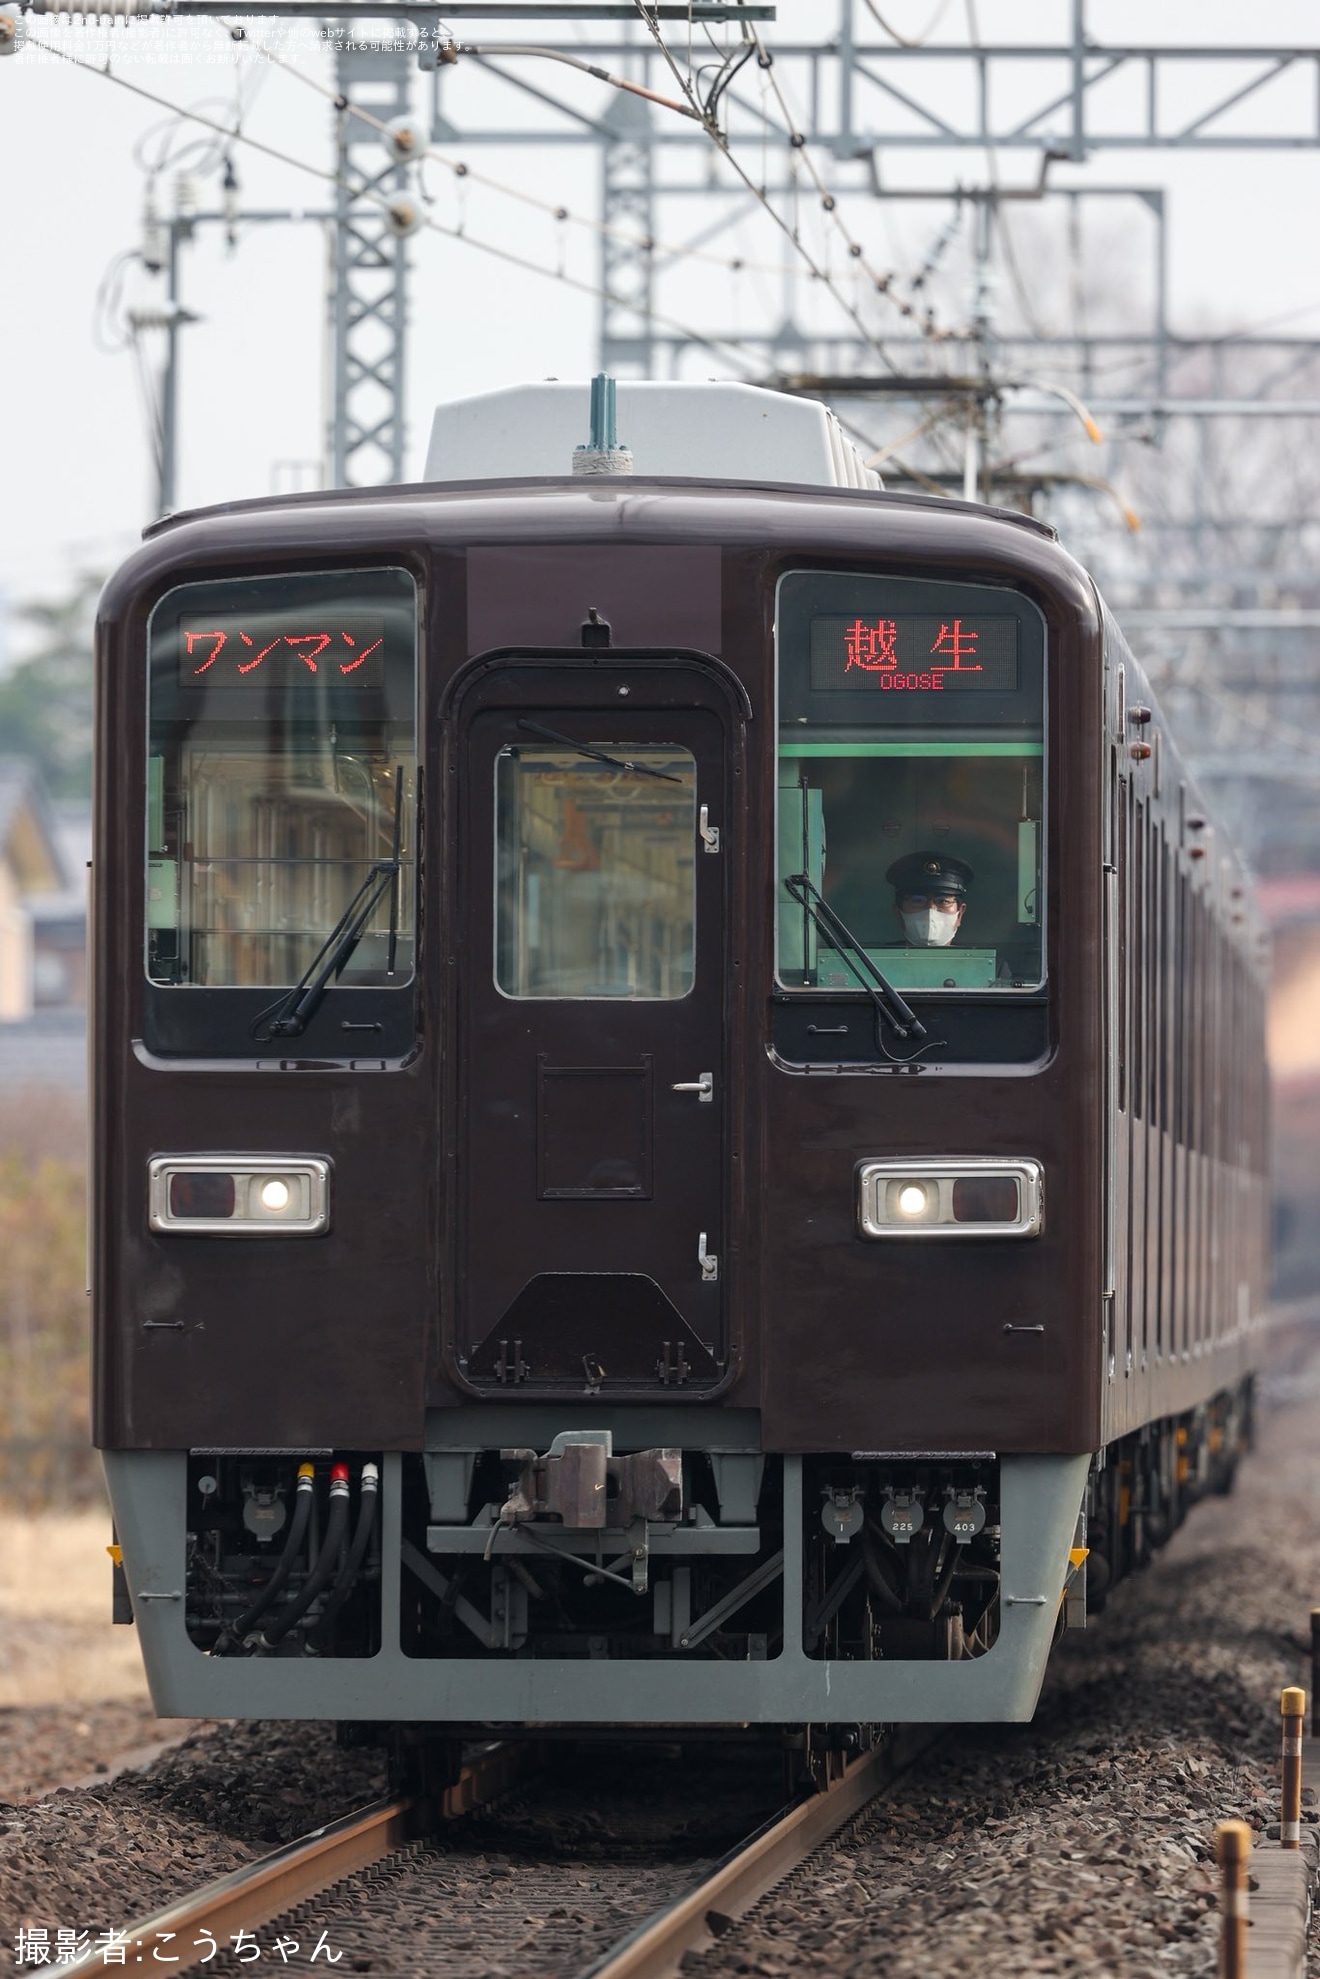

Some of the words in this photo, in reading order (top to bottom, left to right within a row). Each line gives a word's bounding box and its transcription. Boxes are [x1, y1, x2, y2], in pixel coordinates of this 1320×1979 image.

[184, 631, 383, 674] ワンマン
[879, 673, 944, 690] OGOSE
[892, 1522, 913, 1531] 225
[954, 1523, 975, 1532] 403
